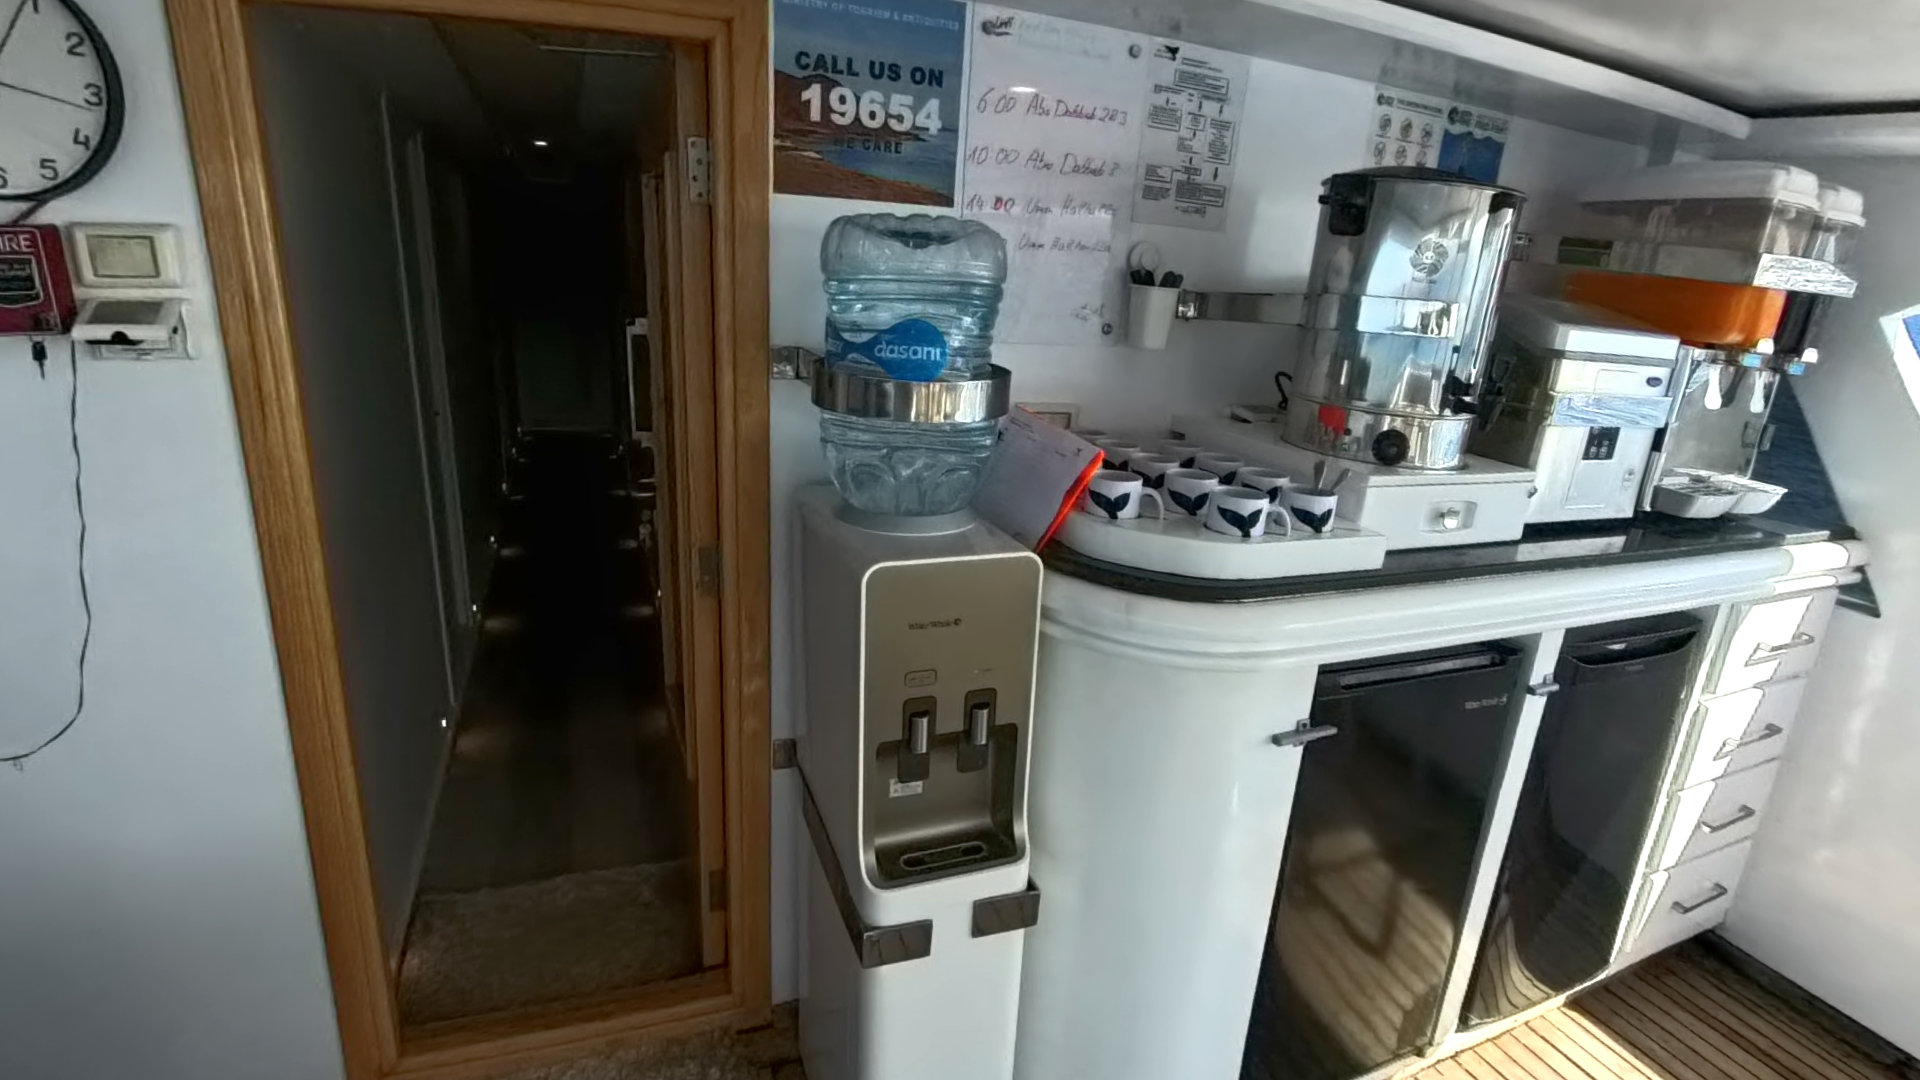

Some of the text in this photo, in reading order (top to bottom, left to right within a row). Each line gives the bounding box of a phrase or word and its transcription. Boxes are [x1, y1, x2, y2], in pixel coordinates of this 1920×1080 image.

[65, 31, 86, 57] 2
[795, 51, 944, 88] CALL US ON
[83, 82, 104, 108] 3
[801, 83, 943, 136] 19654
[73, 127, 91, 150] 4
[833, 137, 903, 154] WE CARE
[39, 158, 60, 181] 5
[0, 233, 36, 252] IRE
[874, 341, 943, 361] dasani
